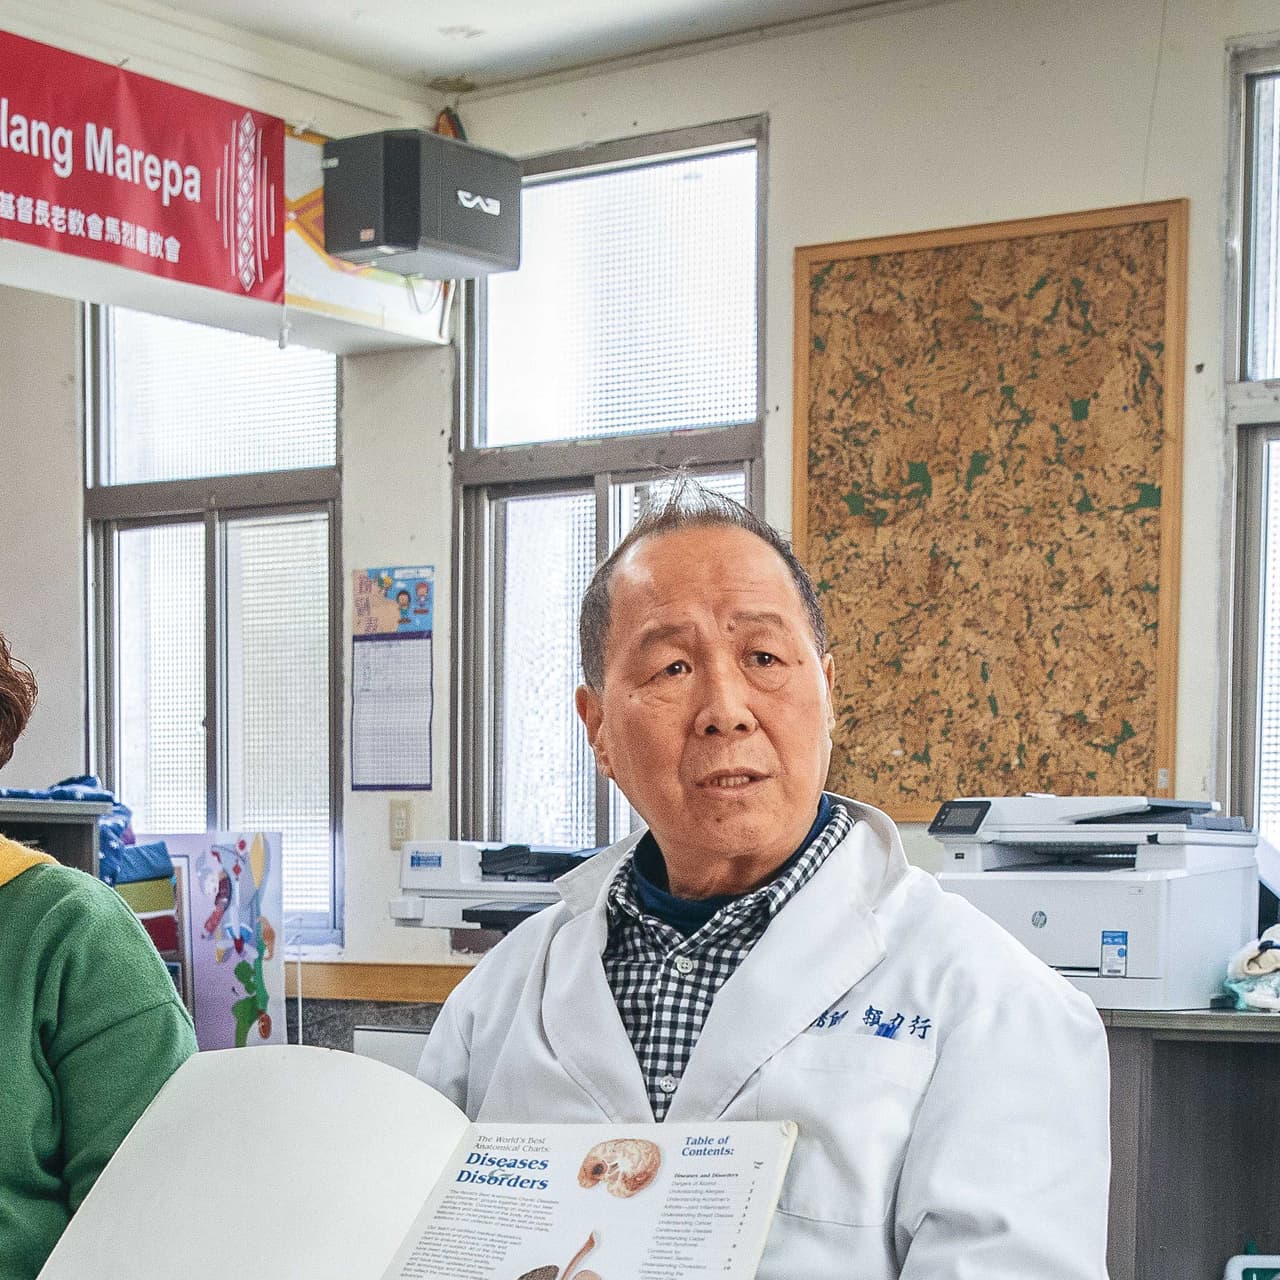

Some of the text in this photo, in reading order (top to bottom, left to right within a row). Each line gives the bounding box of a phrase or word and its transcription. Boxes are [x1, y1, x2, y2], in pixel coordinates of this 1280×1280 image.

[85, 121, 201, 207] Marepa
[477, 1135, 546, 1145] The World's Best
[685, 1135, 731, 1146] Table of
[681, 1146, 735, 1157] Contents:
[465, 1152, 550, 1171] Diseases
[456, 1169, 550, 1191] Disorders
